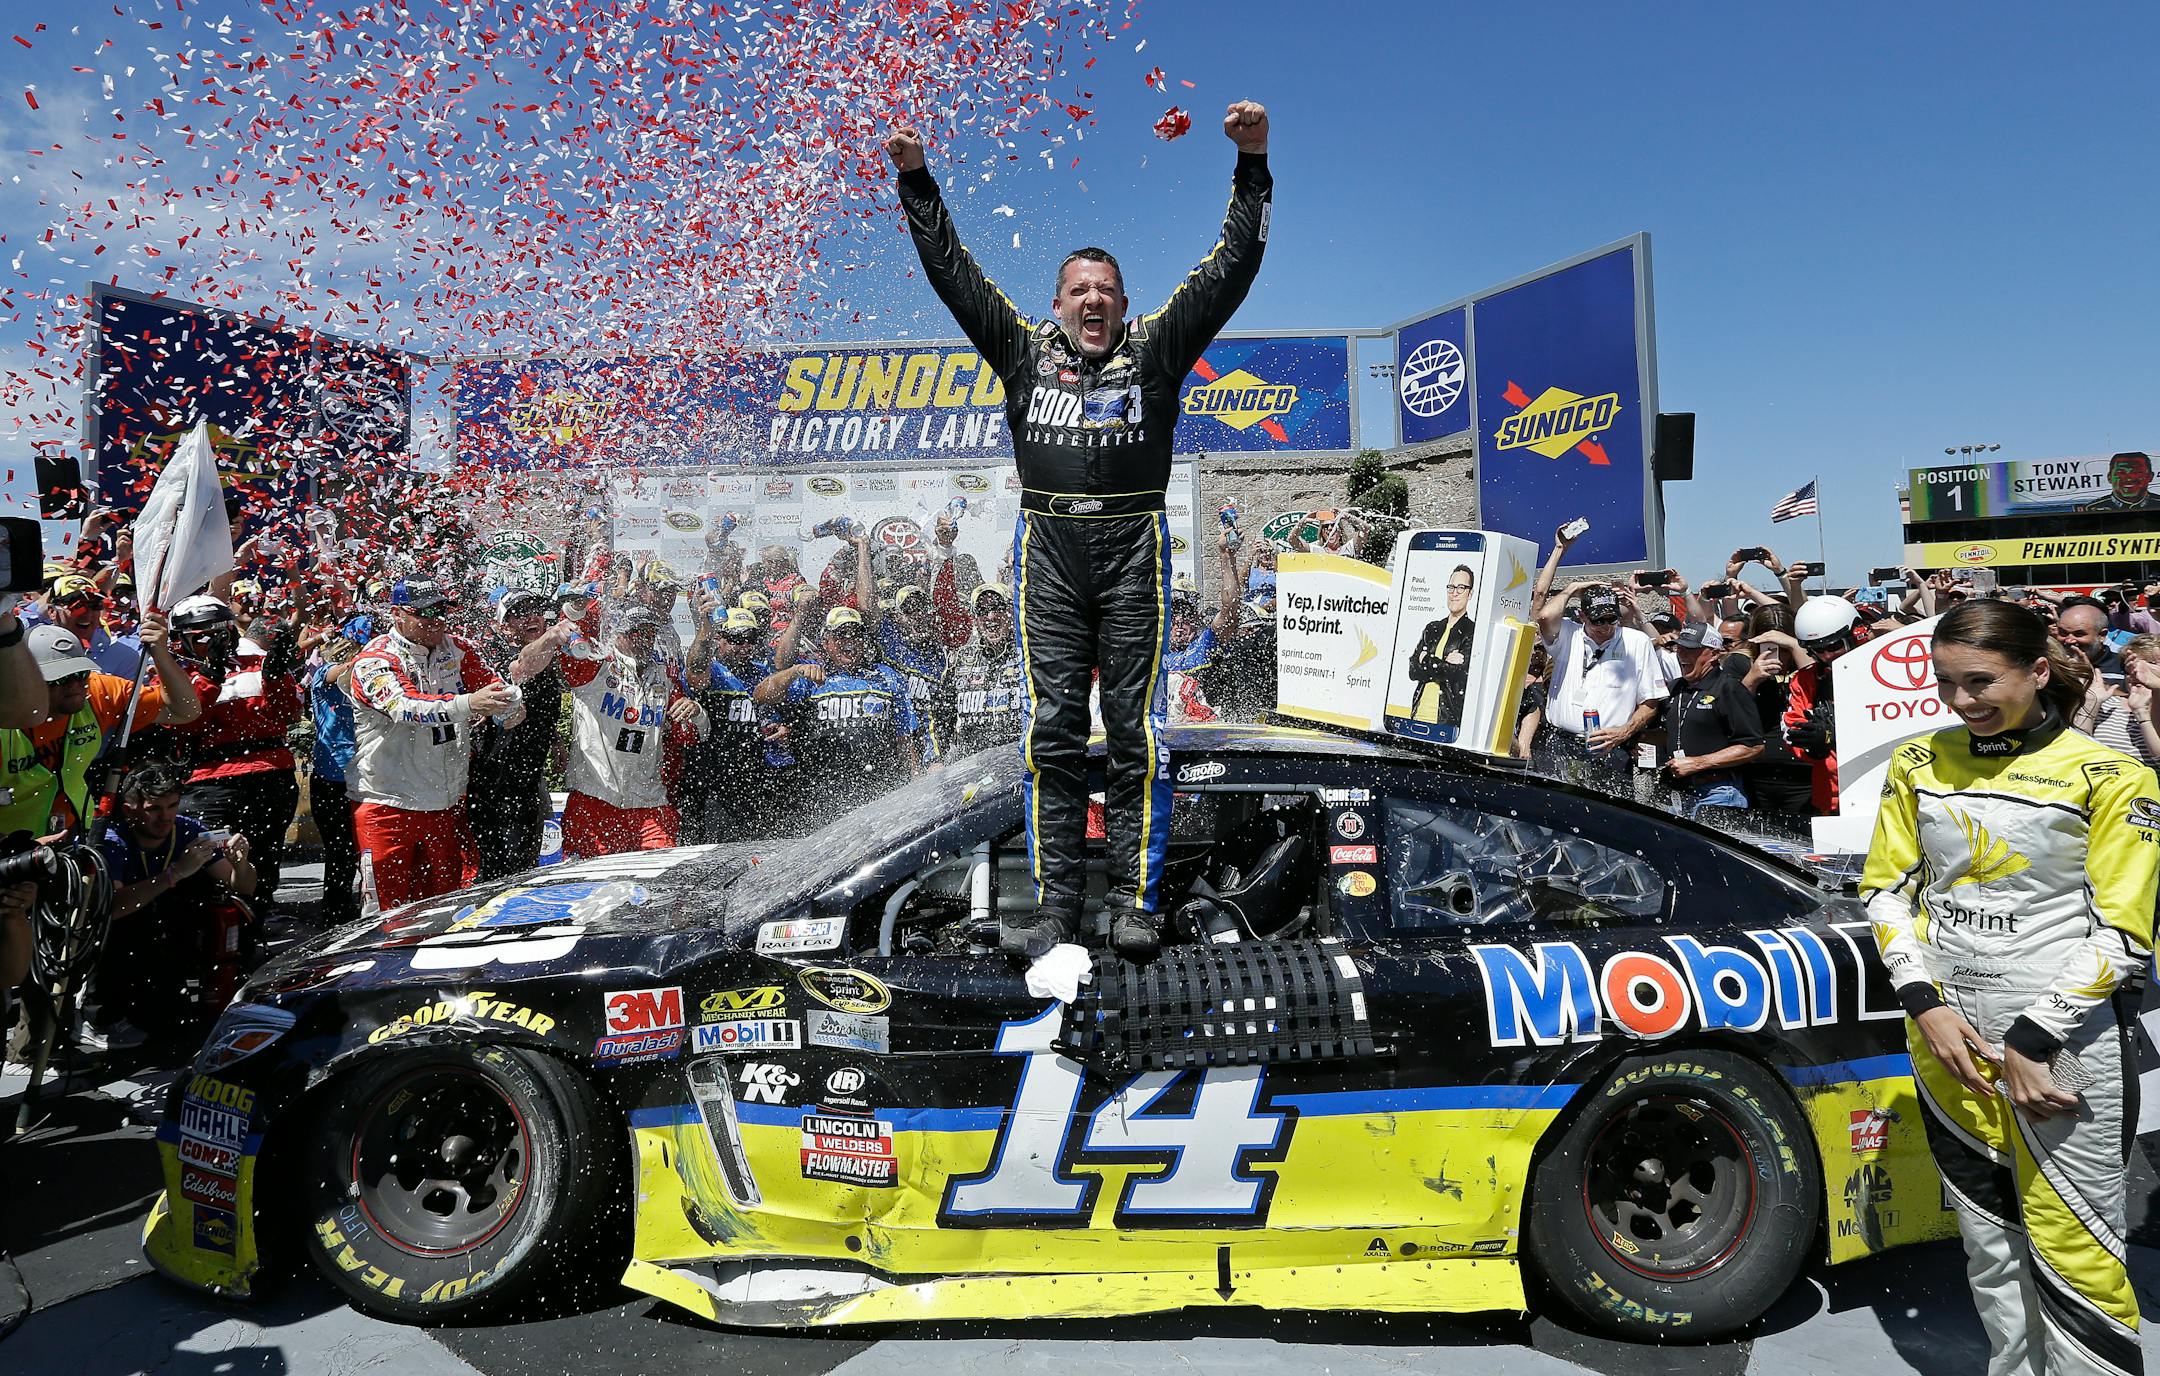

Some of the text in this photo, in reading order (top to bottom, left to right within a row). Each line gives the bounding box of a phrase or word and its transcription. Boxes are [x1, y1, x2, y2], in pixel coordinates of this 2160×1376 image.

[1127, 385, 1142, 424] 3
[1188, 388, 1293, 412] SUNOCO
[769, 411, 1005, 452] VICTORY LANE
[1502, 400, 1614, 447] SUNOCO
[1026, 430, 1145, 447] ASSOCIATES
[1917, 468, 1991, 485] POSITION
[2032, 461, 2081, 477] TONY
[2014, 474, 2104, 493] STEWART
[1069, 499, 1103, 514] Smoke
[1947, 485, 1963, 512] 1
[1959, 549, 1991, 560] PENNZOIL
[1410, 585, 1430, 593] former
[1411, 576, 1427, 585] Paul,
[1287, 592, 1389, 615] Yep, I switched
[1409, 595, 1431, 603] Verizon
[1500, 596, 1522, 610] Sprint
[1407, 604, 1435, 612] customer
[1283, 615, 1343, 635] to Sprint.
[1281, 649, 1322, 662] sprint.com
[1284, 664, 1303, 676] (800)
[1304, 665, 1335, 679] SPRINT-1
[1346, 675, 1371, 688] Sprint
[403, 710, 437, 723] Mobil
[600, 692, 664, 727] Mobi
[817, 698, 861, 720] CODE
[1865, 698, 1953, 721] TOYO
[625, 732, 636, 752] 1
[1976, 742, 2008, 753] Sprint
[1177, 760, 1226, 783] Smoke
[2007, 772, 2074, 788] @MissSprintCup
[1326, 789, 1350, 802] CODE
[543, 832, 560, 840] SCH
[1332, 847, 1374, 862] Coca-Cola
[1353, 872, 1368, 880] Bass
[1354, 885, 1373, 894] Shops
[1942, 900, 2018, 933] Sprint
[761, 941, 799, 949] RACE
[1887, 952, 1912, 980] print
[1952, 965, 2003, 980] Julianna
[830, 983, 860, 996] Sprint
[1467, 927, 1838, 1047] Mobil
[607, 989, 682, 1032] 3M
[701, 1007, 787, 1022] MECHANIX WEAR
[699, 1022, 766, 1046] Mobil
[599, 1031, 679, 1057] Duralast
[620, 1053, 659, 1065] BRAKES
[185, 1073, 256, 1114] MOOG
[823, 1096, 850, 1105] Ingersoll
[944, 998, 1287, 1215] 14
[181, 1101, 250, 1145] MAHLE
[806, 1118, 876, 1138] LINCOLN
[181, 1138, 231, 1166] COMP
[821, 1136, 883, 1153] WELDERS
[1856, 1137, 1885, 1150] HAAS
[806, 1152, 891, 1178] FLOWMASTER
[195, 1222, 234, 1242] SUNOC
[1475, 1243, 1504, 1251] NORTON
[1615, 1237, 1636, 1251] AERO
